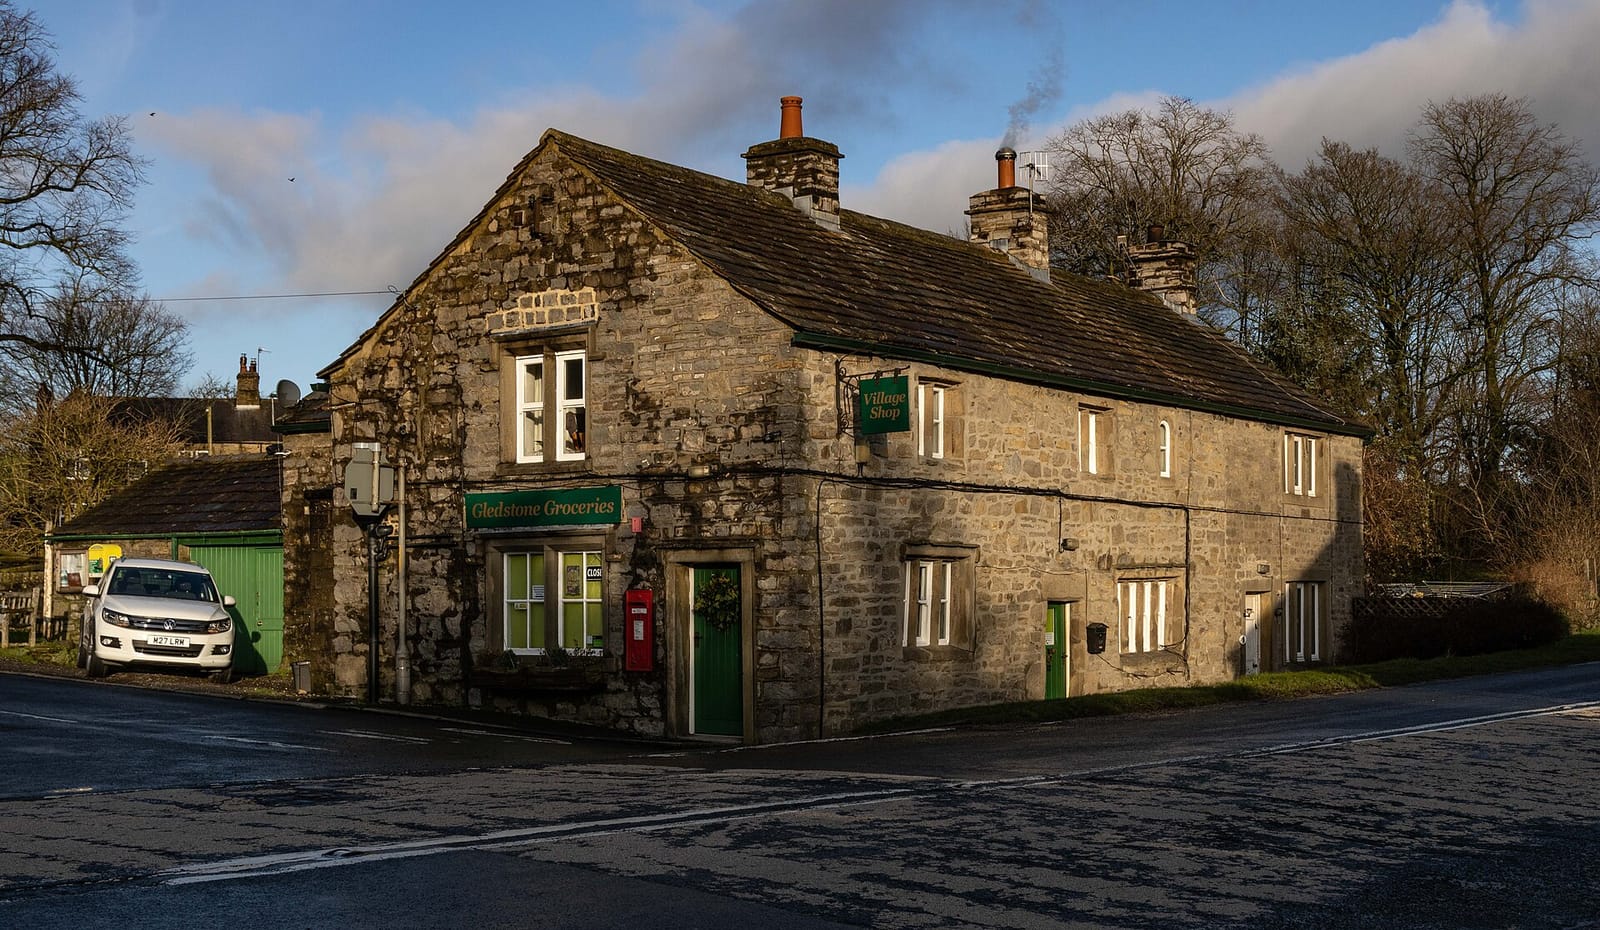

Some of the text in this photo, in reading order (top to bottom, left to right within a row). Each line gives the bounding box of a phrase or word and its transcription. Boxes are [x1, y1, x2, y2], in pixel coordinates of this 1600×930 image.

[864, 391, 906, 407] Village
[870, 406, 901, 421] Shop
[471, 497, 615, 519] Gledstone Groceries
